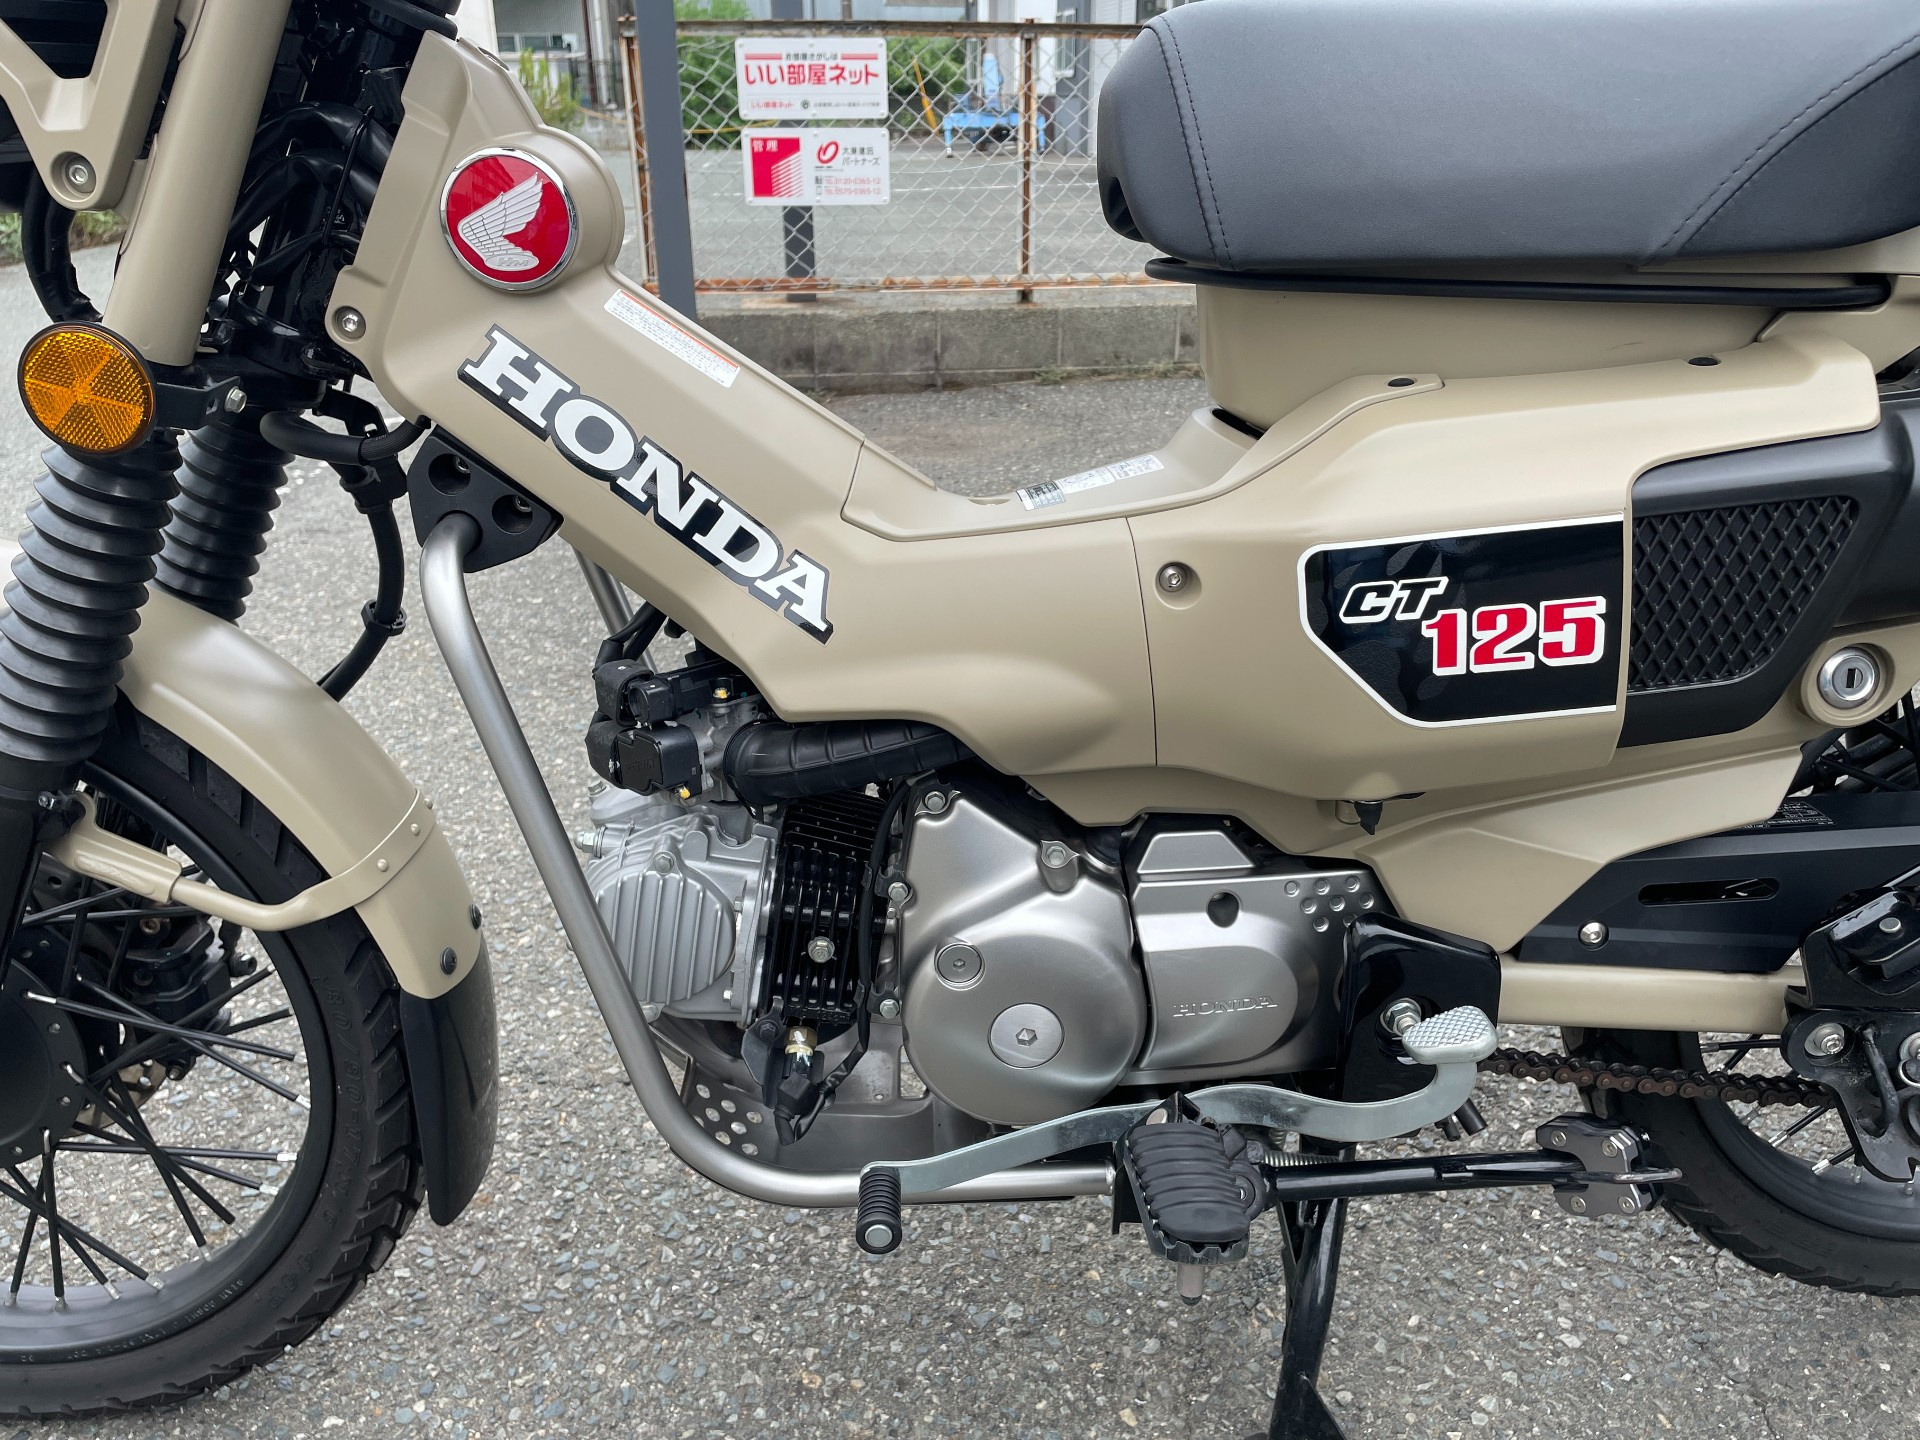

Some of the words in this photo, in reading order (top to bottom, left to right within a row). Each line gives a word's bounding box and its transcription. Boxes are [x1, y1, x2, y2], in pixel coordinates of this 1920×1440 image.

[744, 63, 879, 86] いい部屋ネット
[841, 157, 881, 167] パートナーズ
[461, 327, 831, 635] HONDA
[1339, 576, 1449, 624] CT
[1421, 596, 1606, 676] 125
[1173, 996, 1278, 1018] HONDA
